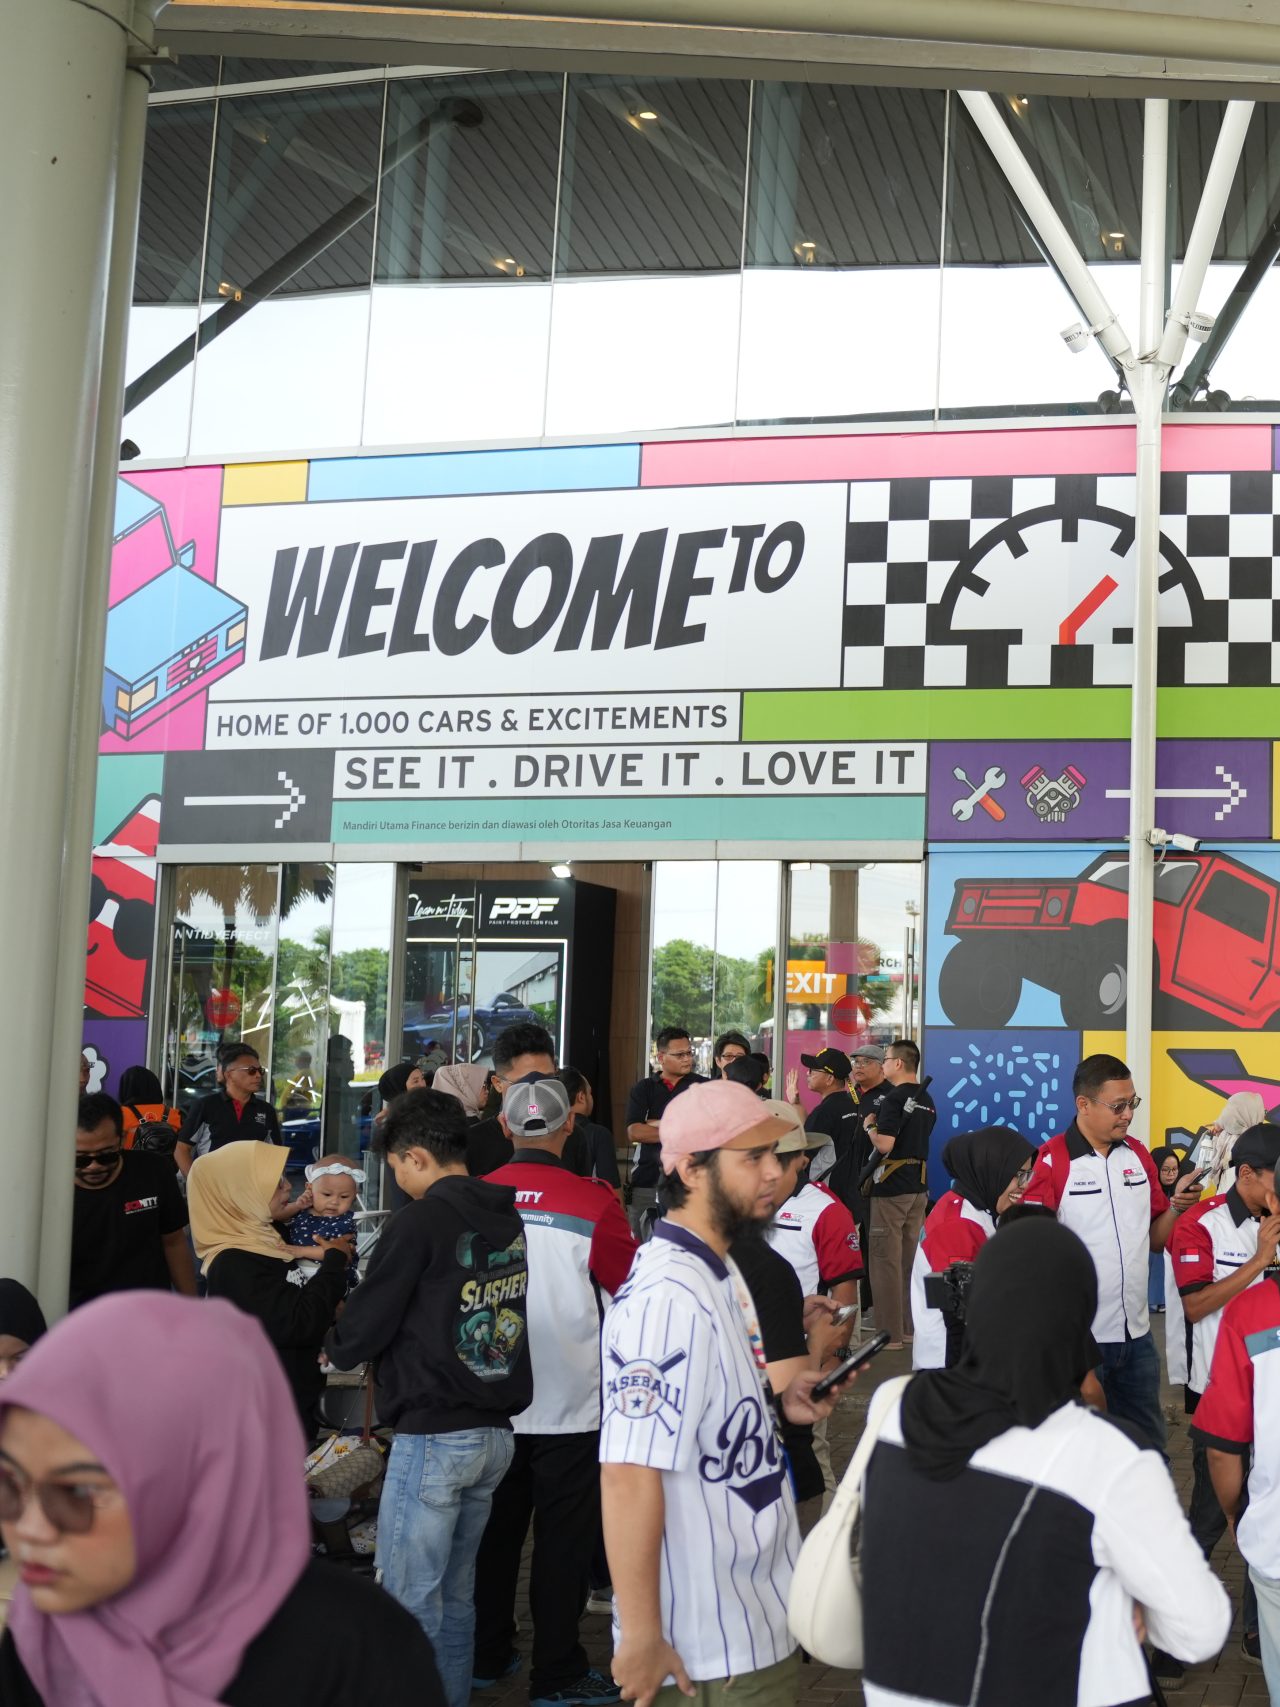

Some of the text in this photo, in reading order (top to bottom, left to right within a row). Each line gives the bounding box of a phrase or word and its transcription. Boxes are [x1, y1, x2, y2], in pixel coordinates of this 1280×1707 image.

[259, 521, 805, 662] WELCOME TO
[217, 705, 727, 737] HOME OF 1.000 CARS & EXCITEMENTS
[345, 756, 420, 789] SEE
[438, 756, 474, 789] IT
[514, 753, 643, 788] DRIVE
[662, 753, 700, 786] IT
[742, 750, 855, 785] LOVE
[876, 751, 914, 784] IT
[343, 820, 672, 831] Mandiri Utama Finance berizin dan diawasi oleh Otoritas Jasa Keuangan
[489, 897, 560, 919] PPF
[786, 972, 837, 994] EXIT
[460, 1270, 527, 1313] SLASHER
